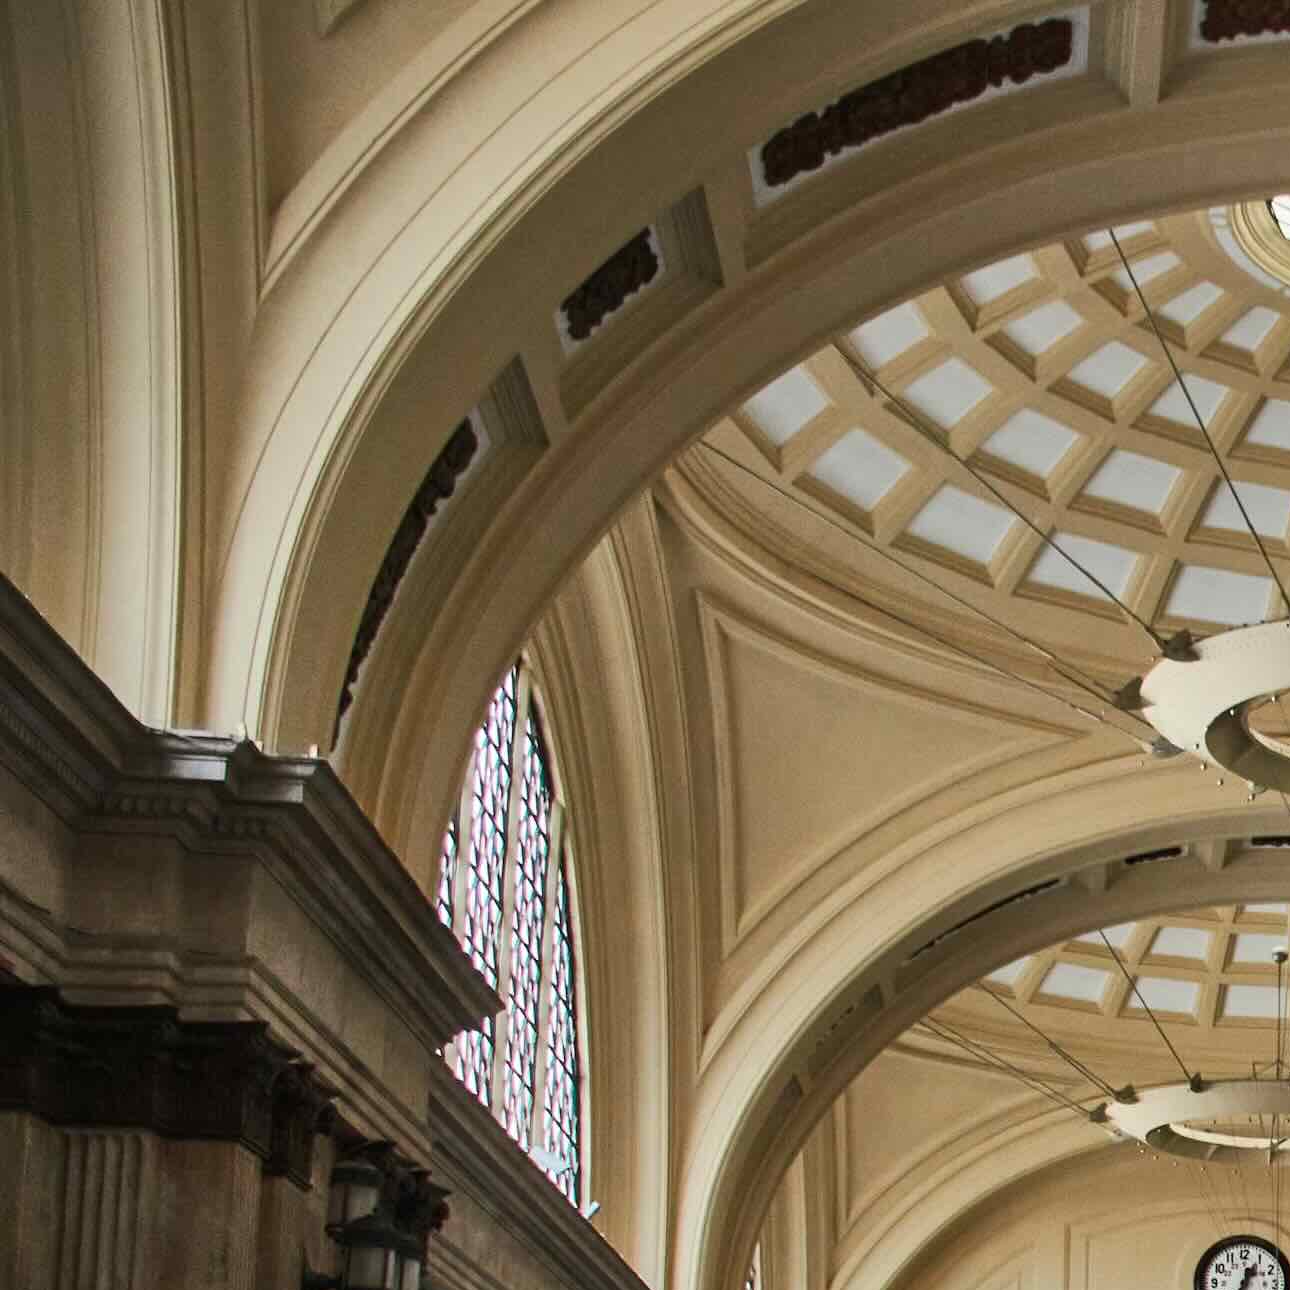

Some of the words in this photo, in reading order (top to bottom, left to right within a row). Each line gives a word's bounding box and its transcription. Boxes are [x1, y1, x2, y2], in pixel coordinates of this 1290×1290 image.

[1226, 1253, 1234, 1263] 11
[1240, 1250, 1250, 1259] 12
[1216, 1263, 1225, 1274] 10
[1268, 1264, 1274, 1275] 2
[1211, 1279, 1218, 1288] 9
